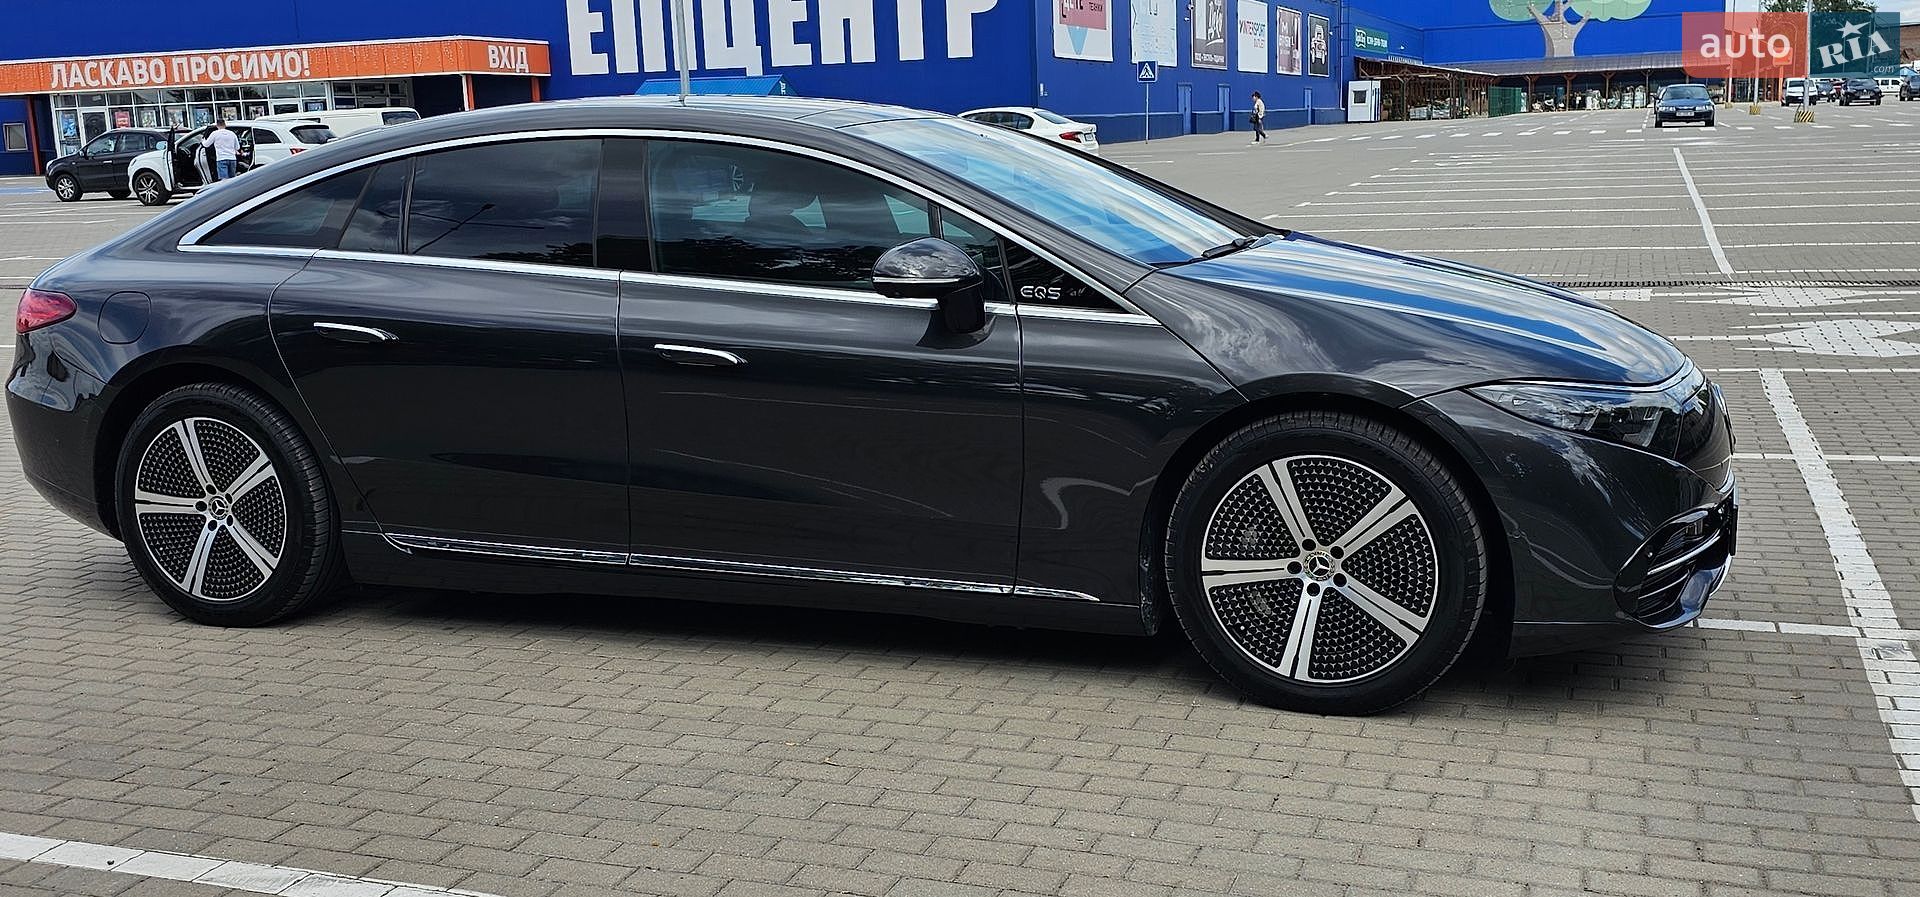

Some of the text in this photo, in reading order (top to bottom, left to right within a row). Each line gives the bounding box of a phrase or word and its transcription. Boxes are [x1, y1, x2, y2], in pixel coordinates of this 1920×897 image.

[51, 51, 310, 88] ЛАСКАВО ПРОСИМО!
[488, 45, 529, 73] ВХІД
[1020, 285, 1061, 300] EQS
